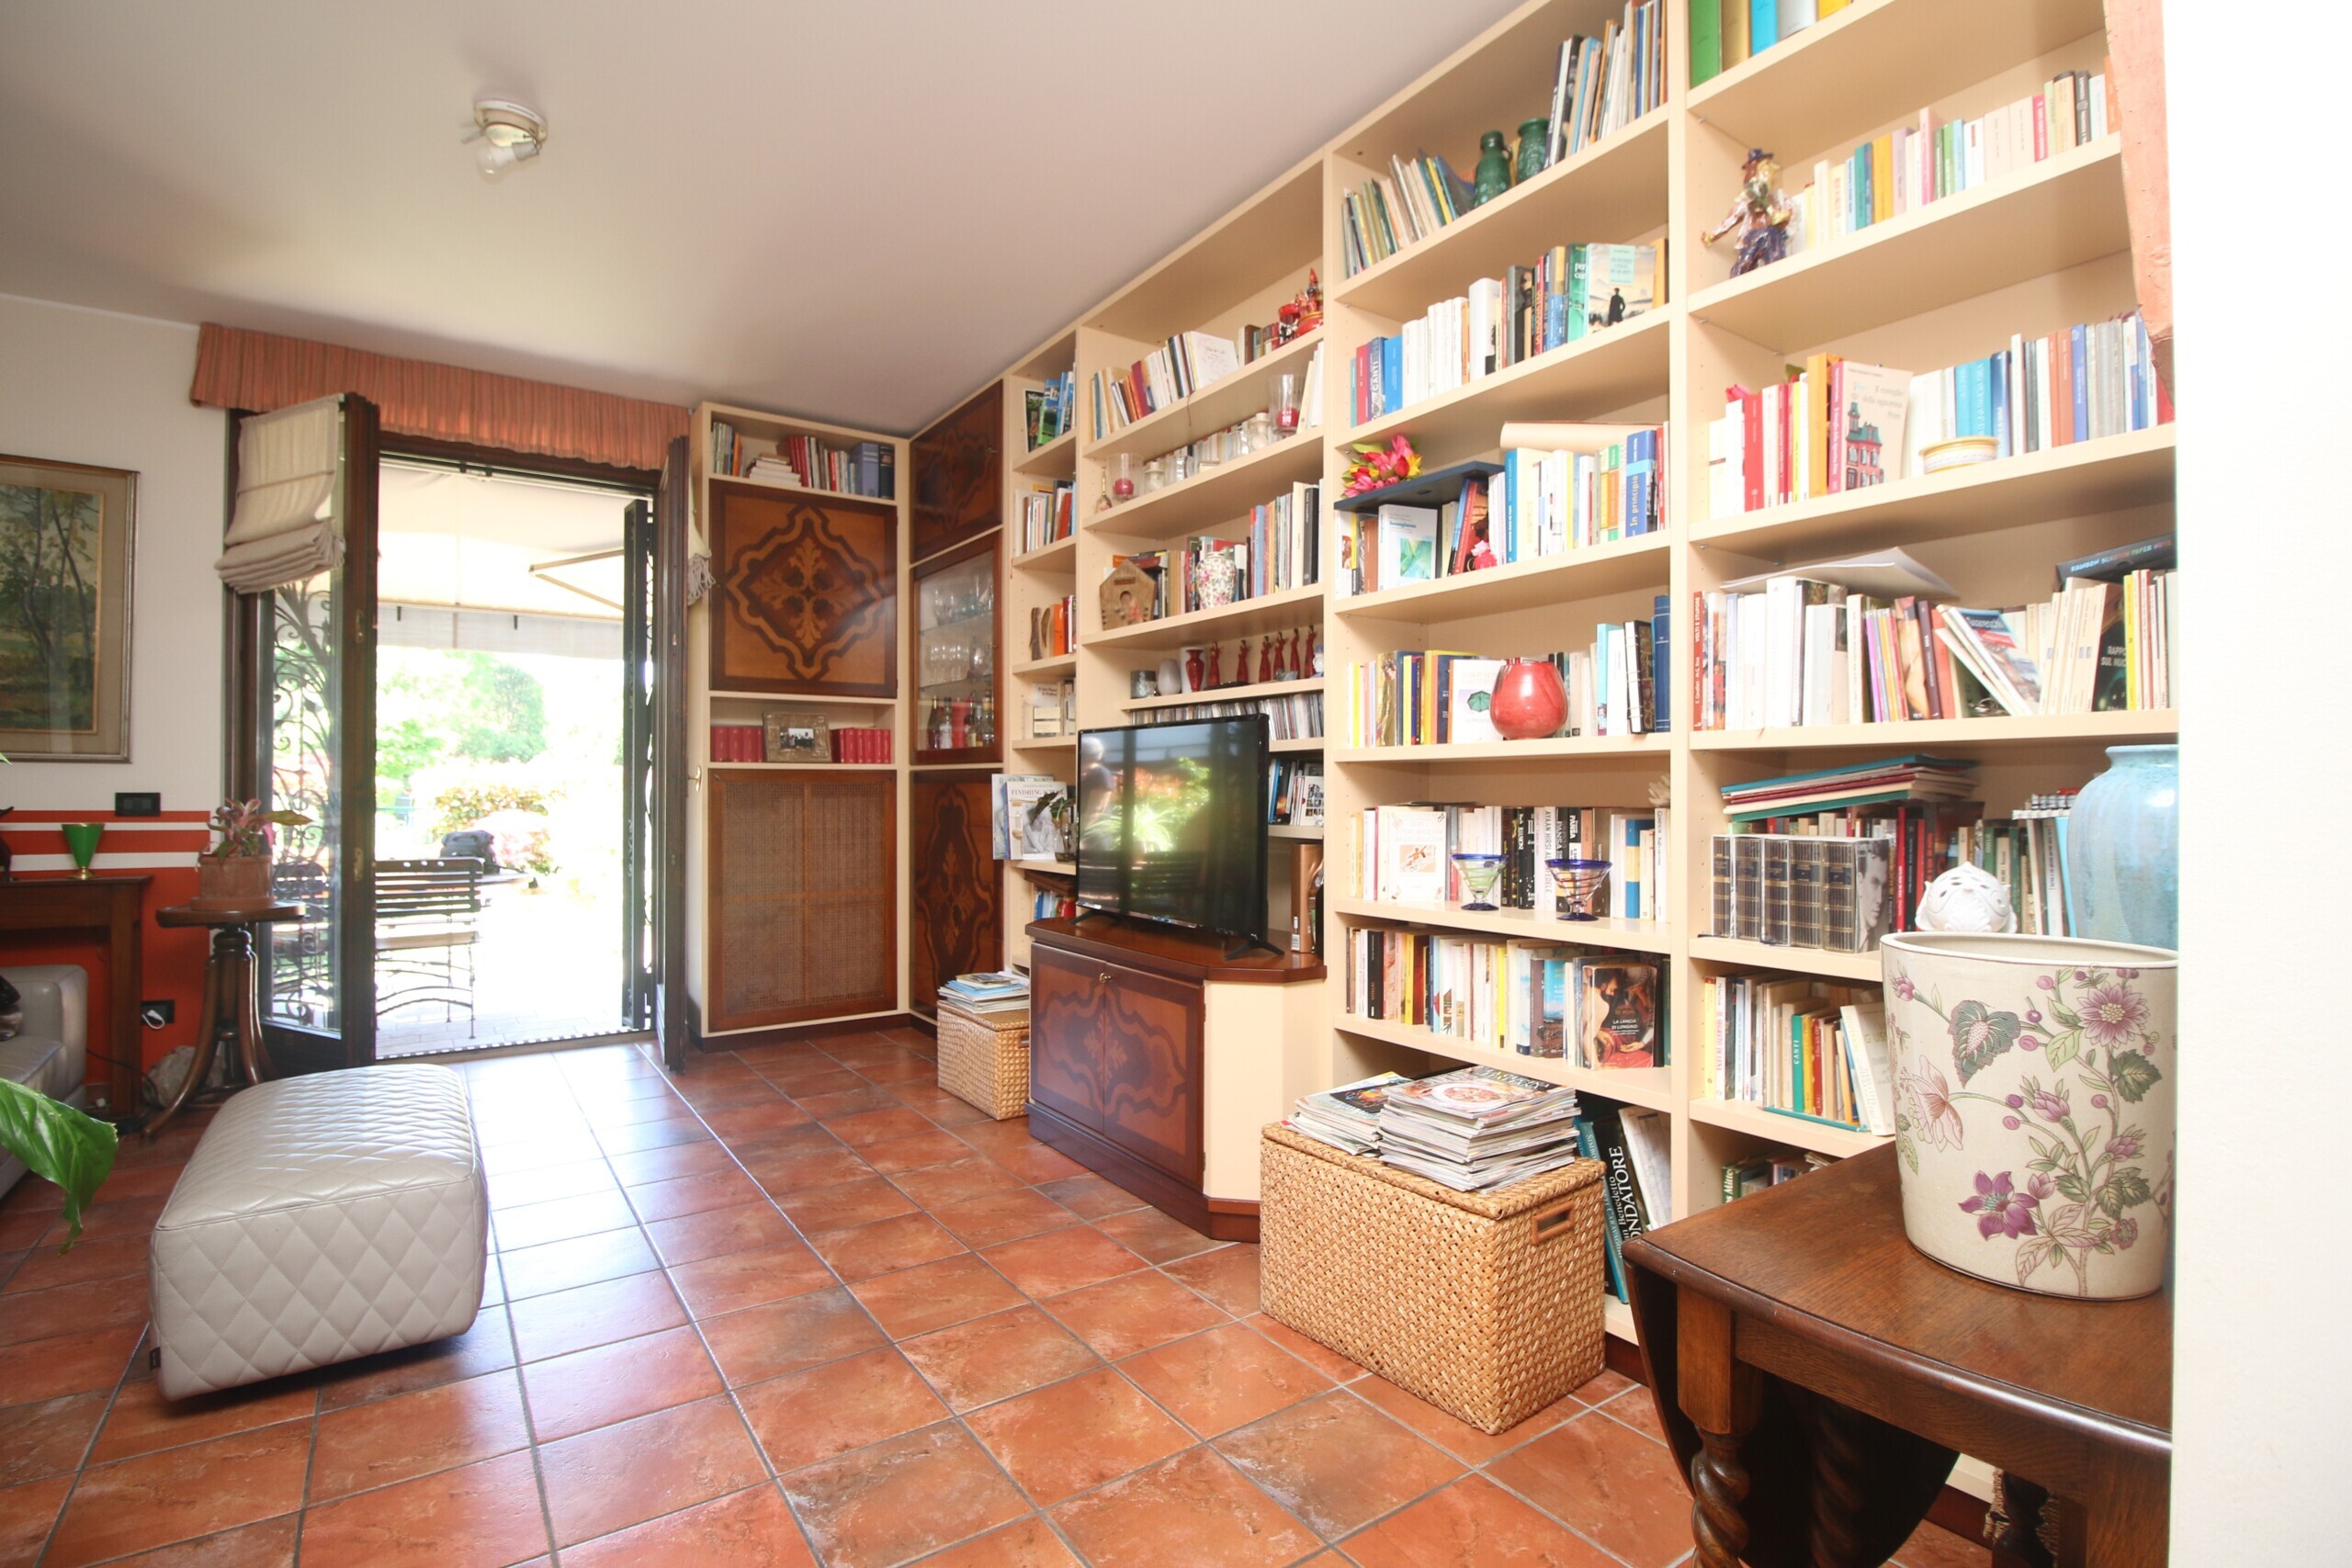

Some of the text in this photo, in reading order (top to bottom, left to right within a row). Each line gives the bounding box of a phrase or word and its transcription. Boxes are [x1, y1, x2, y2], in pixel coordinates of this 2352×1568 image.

[1630, 517, 1638, 526] In
[2071, 558, 2099, 572] RAINBOW
[2108, 646, 2126, 655] RAPPO
[2101, 657, 2126, 667] SUL NUC
[1586, 1134, 1598, 1161] SIMBO
[1605, 1208, 1623, 1258] CARAVAGGIO
[1609, 1145, 1642, 1237] ONDATORE
[1609, 1177, 1630, 1239] an Benedetto
